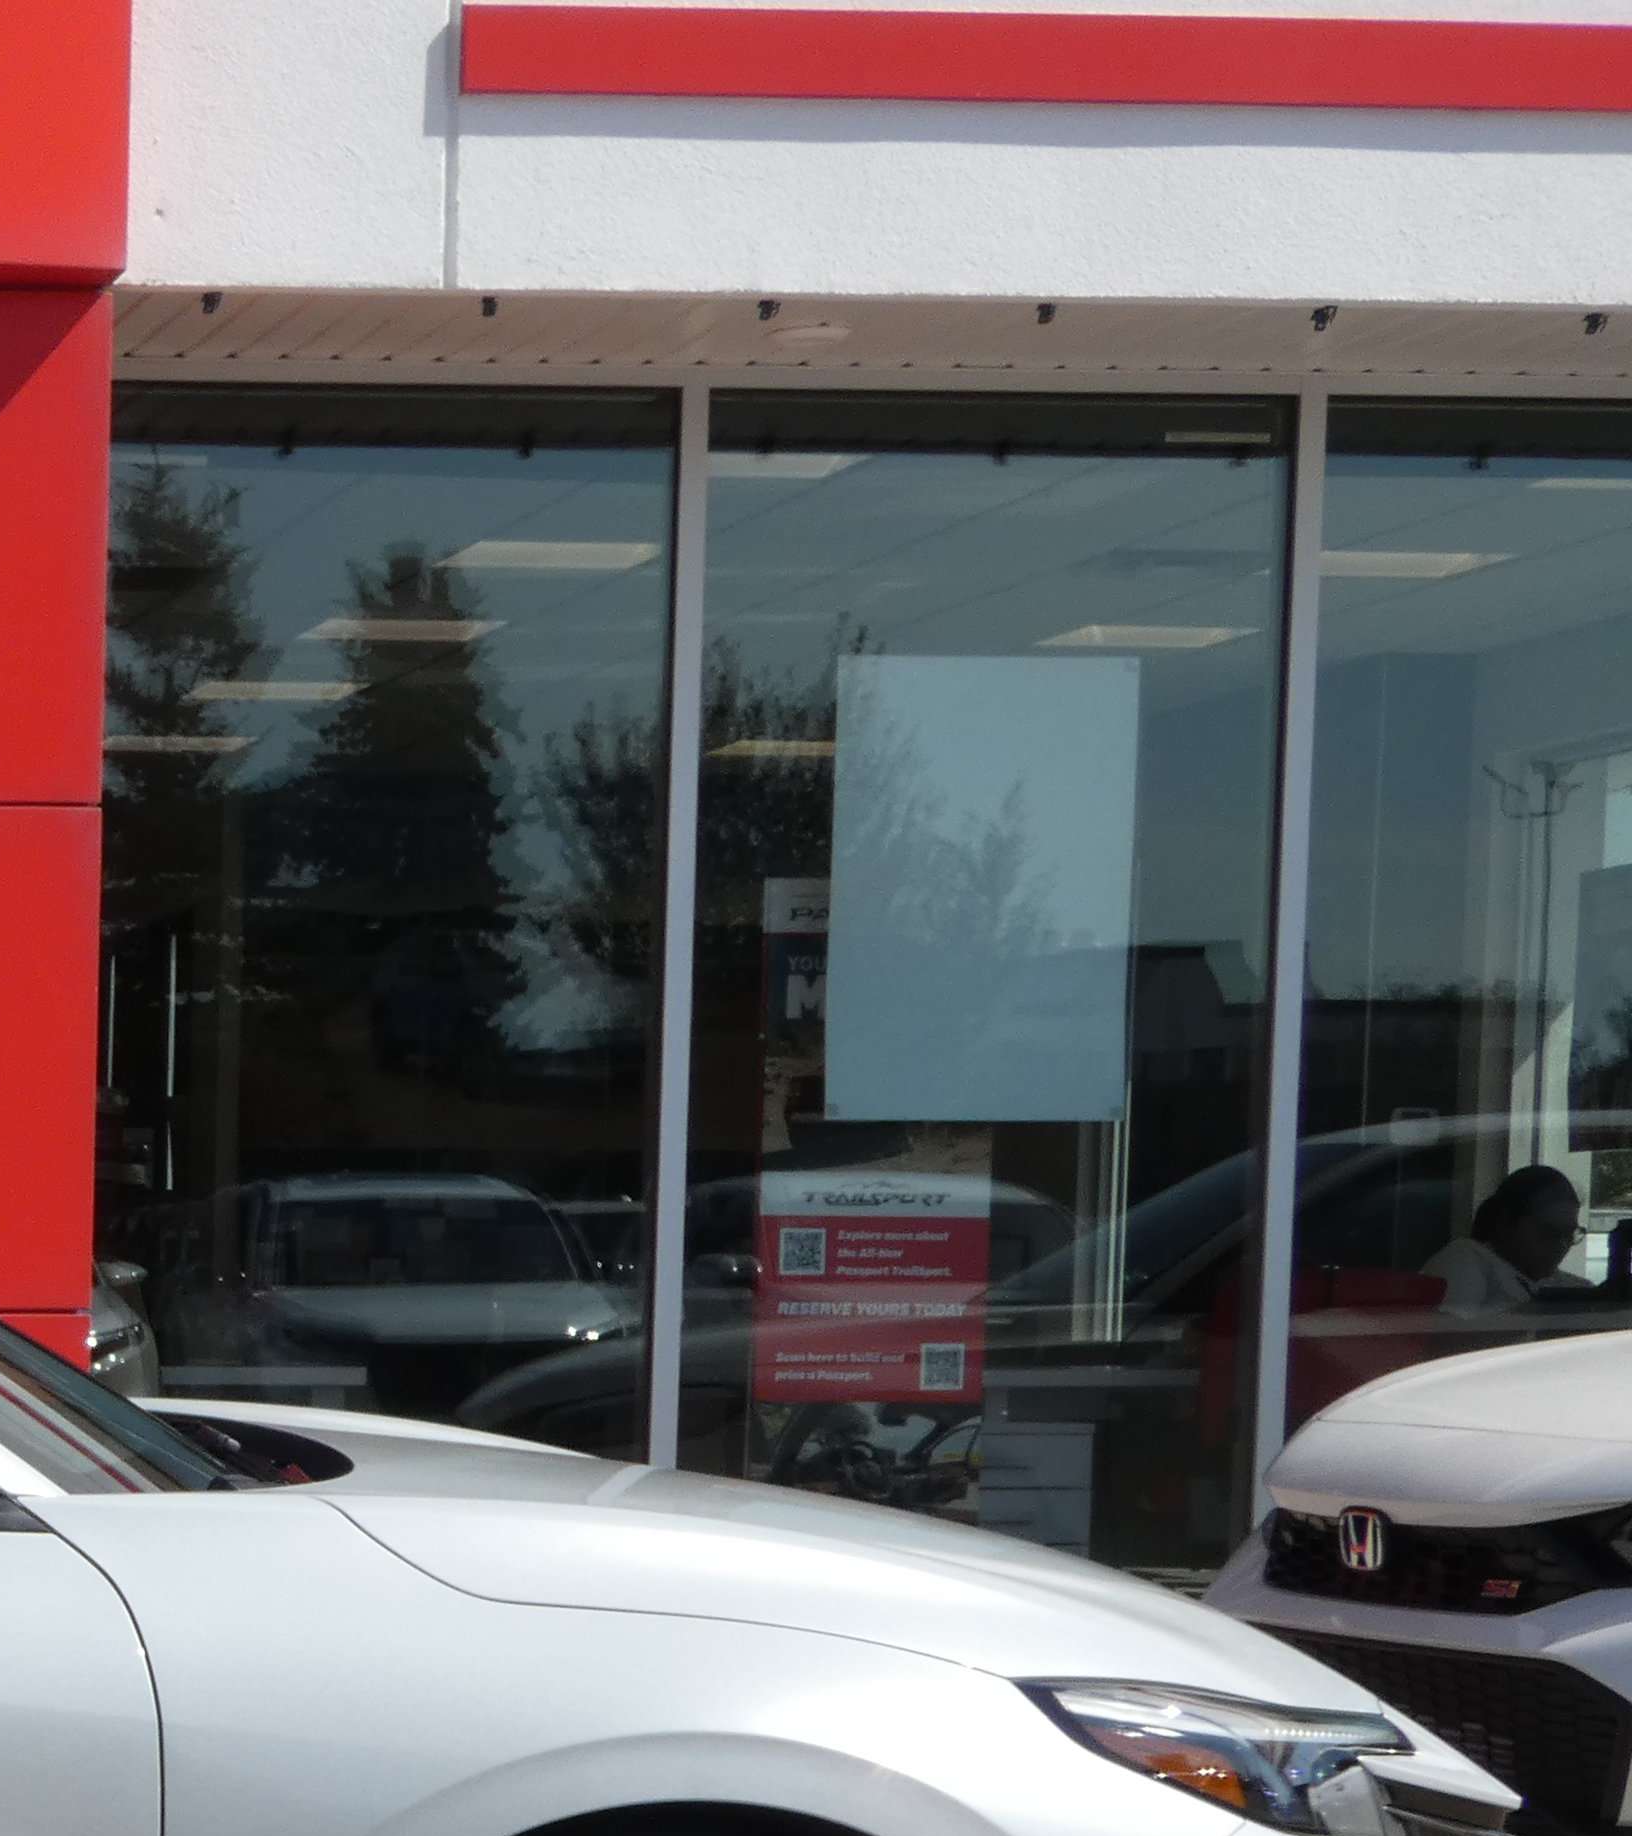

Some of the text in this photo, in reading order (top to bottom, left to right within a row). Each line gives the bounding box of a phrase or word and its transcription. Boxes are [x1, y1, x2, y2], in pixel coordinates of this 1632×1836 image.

[778, 1302, 967, 1317] RESERVE YOURS TODAY
